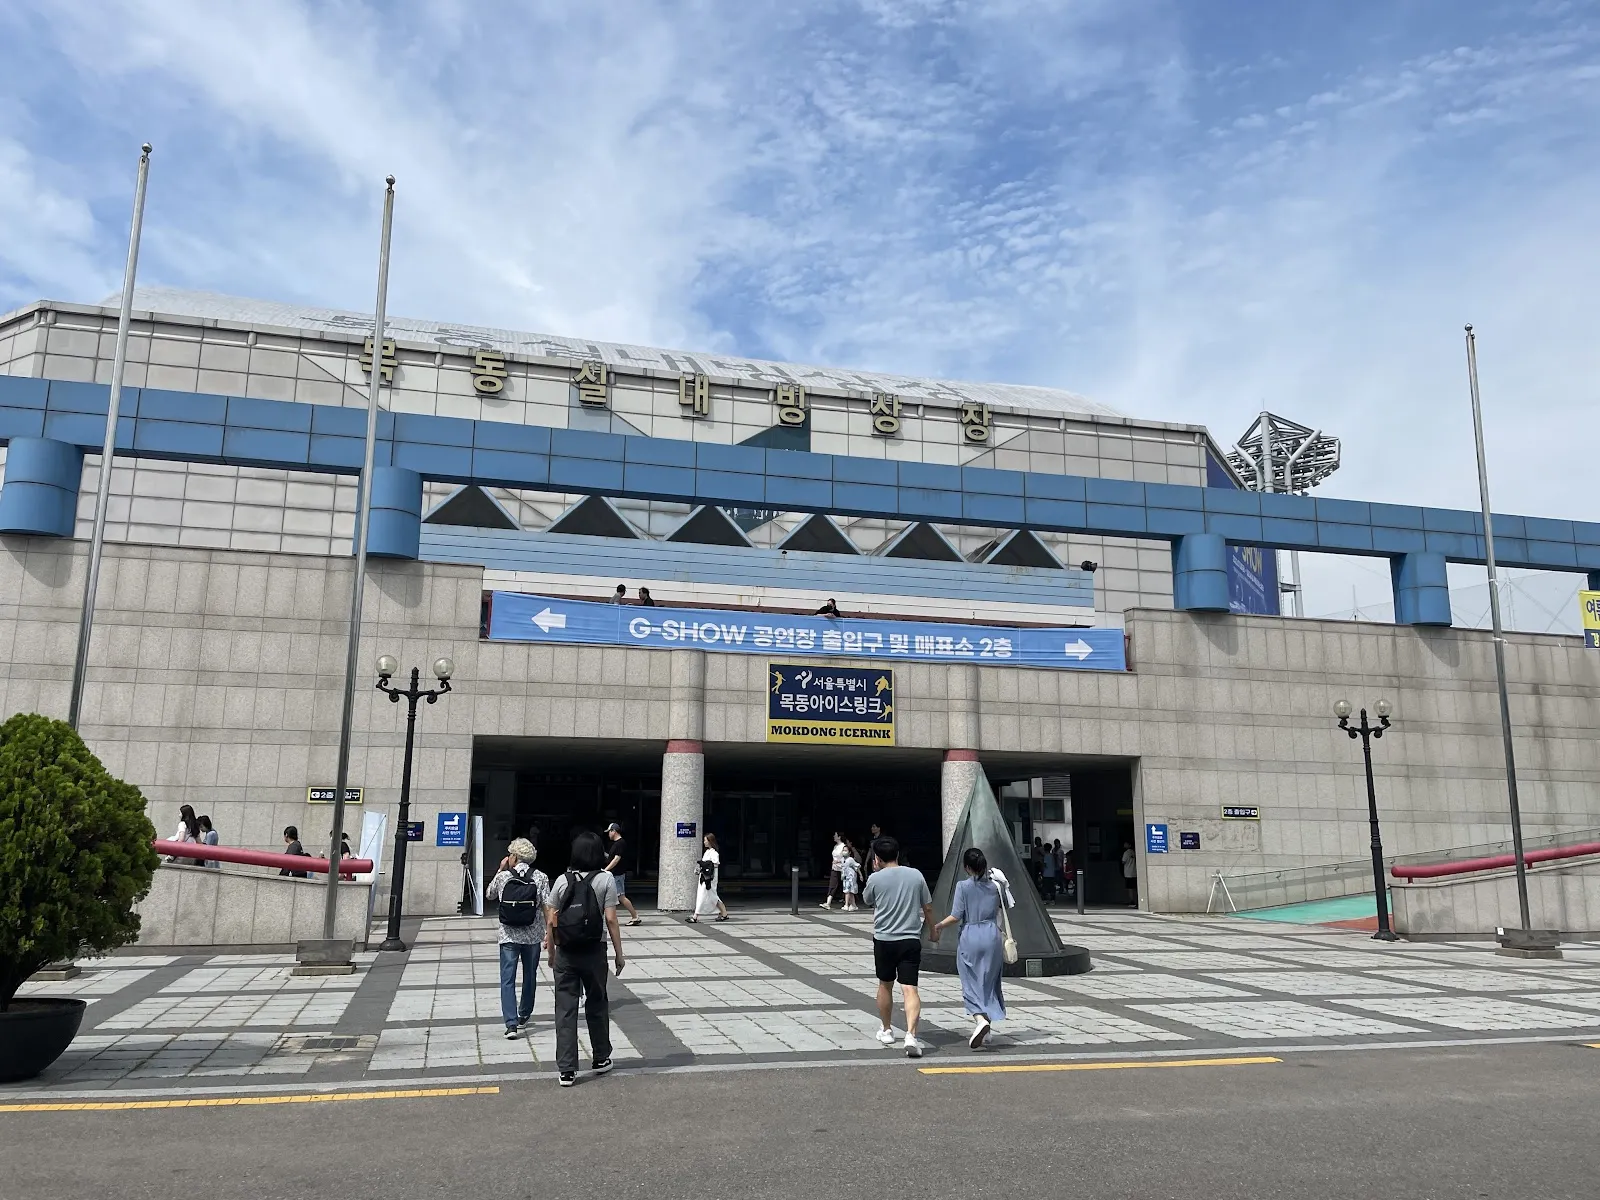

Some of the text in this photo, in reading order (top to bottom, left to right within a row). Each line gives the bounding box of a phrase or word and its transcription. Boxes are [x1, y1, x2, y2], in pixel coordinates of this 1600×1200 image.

[629, 617, 1012, 658] G-SHOW 공연장 출입구 및 매표소 2층
[813, 677, 867, 691] 서울특별시
[780, 694, 882, 715] 목동아이스링크
[771, 726, 891, 739] MOKDONG ICERINK
